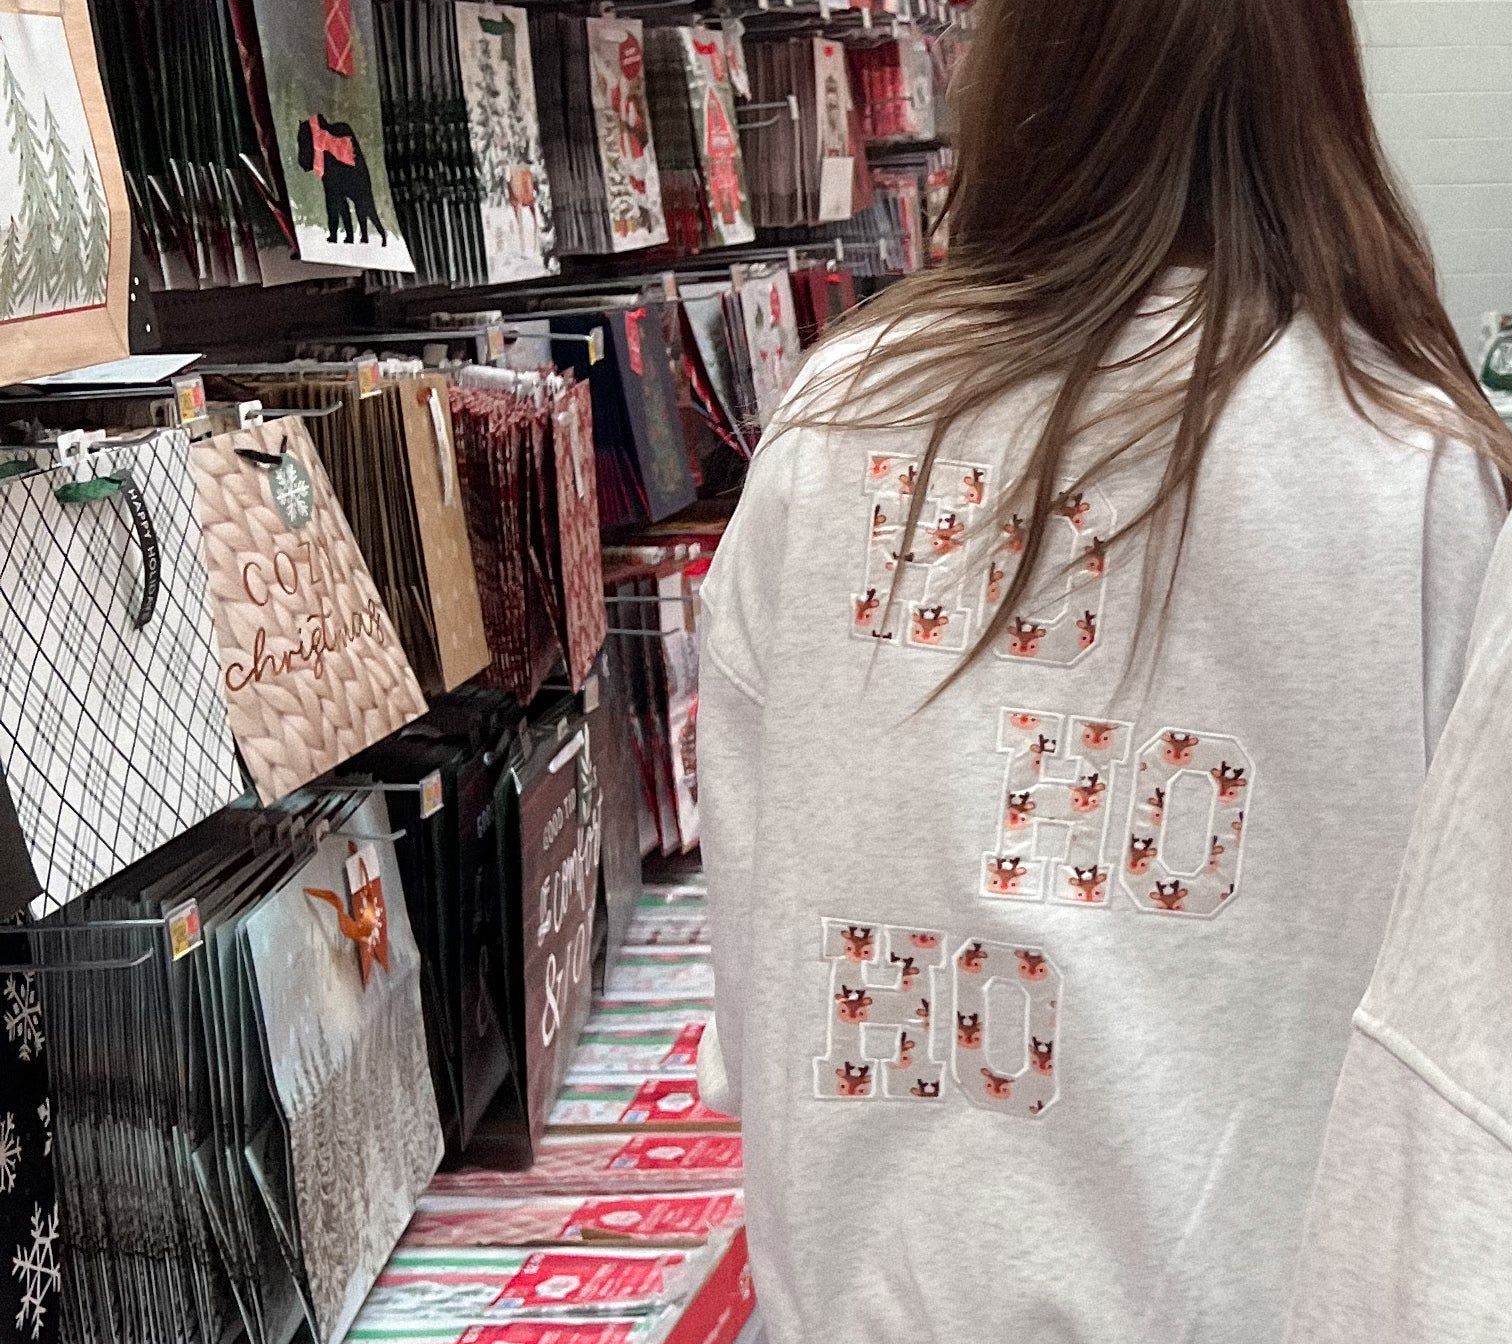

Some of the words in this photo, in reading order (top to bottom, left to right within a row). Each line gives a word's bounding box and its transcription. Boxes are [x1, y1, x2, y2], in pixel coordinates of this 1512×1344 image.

[128, 488, 152, 539] HAPPY
[140, 545, 159, 624] HOLIDA
[851, 452, 1117, 668] HO
[979, 705, 1258, 921] HO
[813, 916, 1065, 1121] HO
